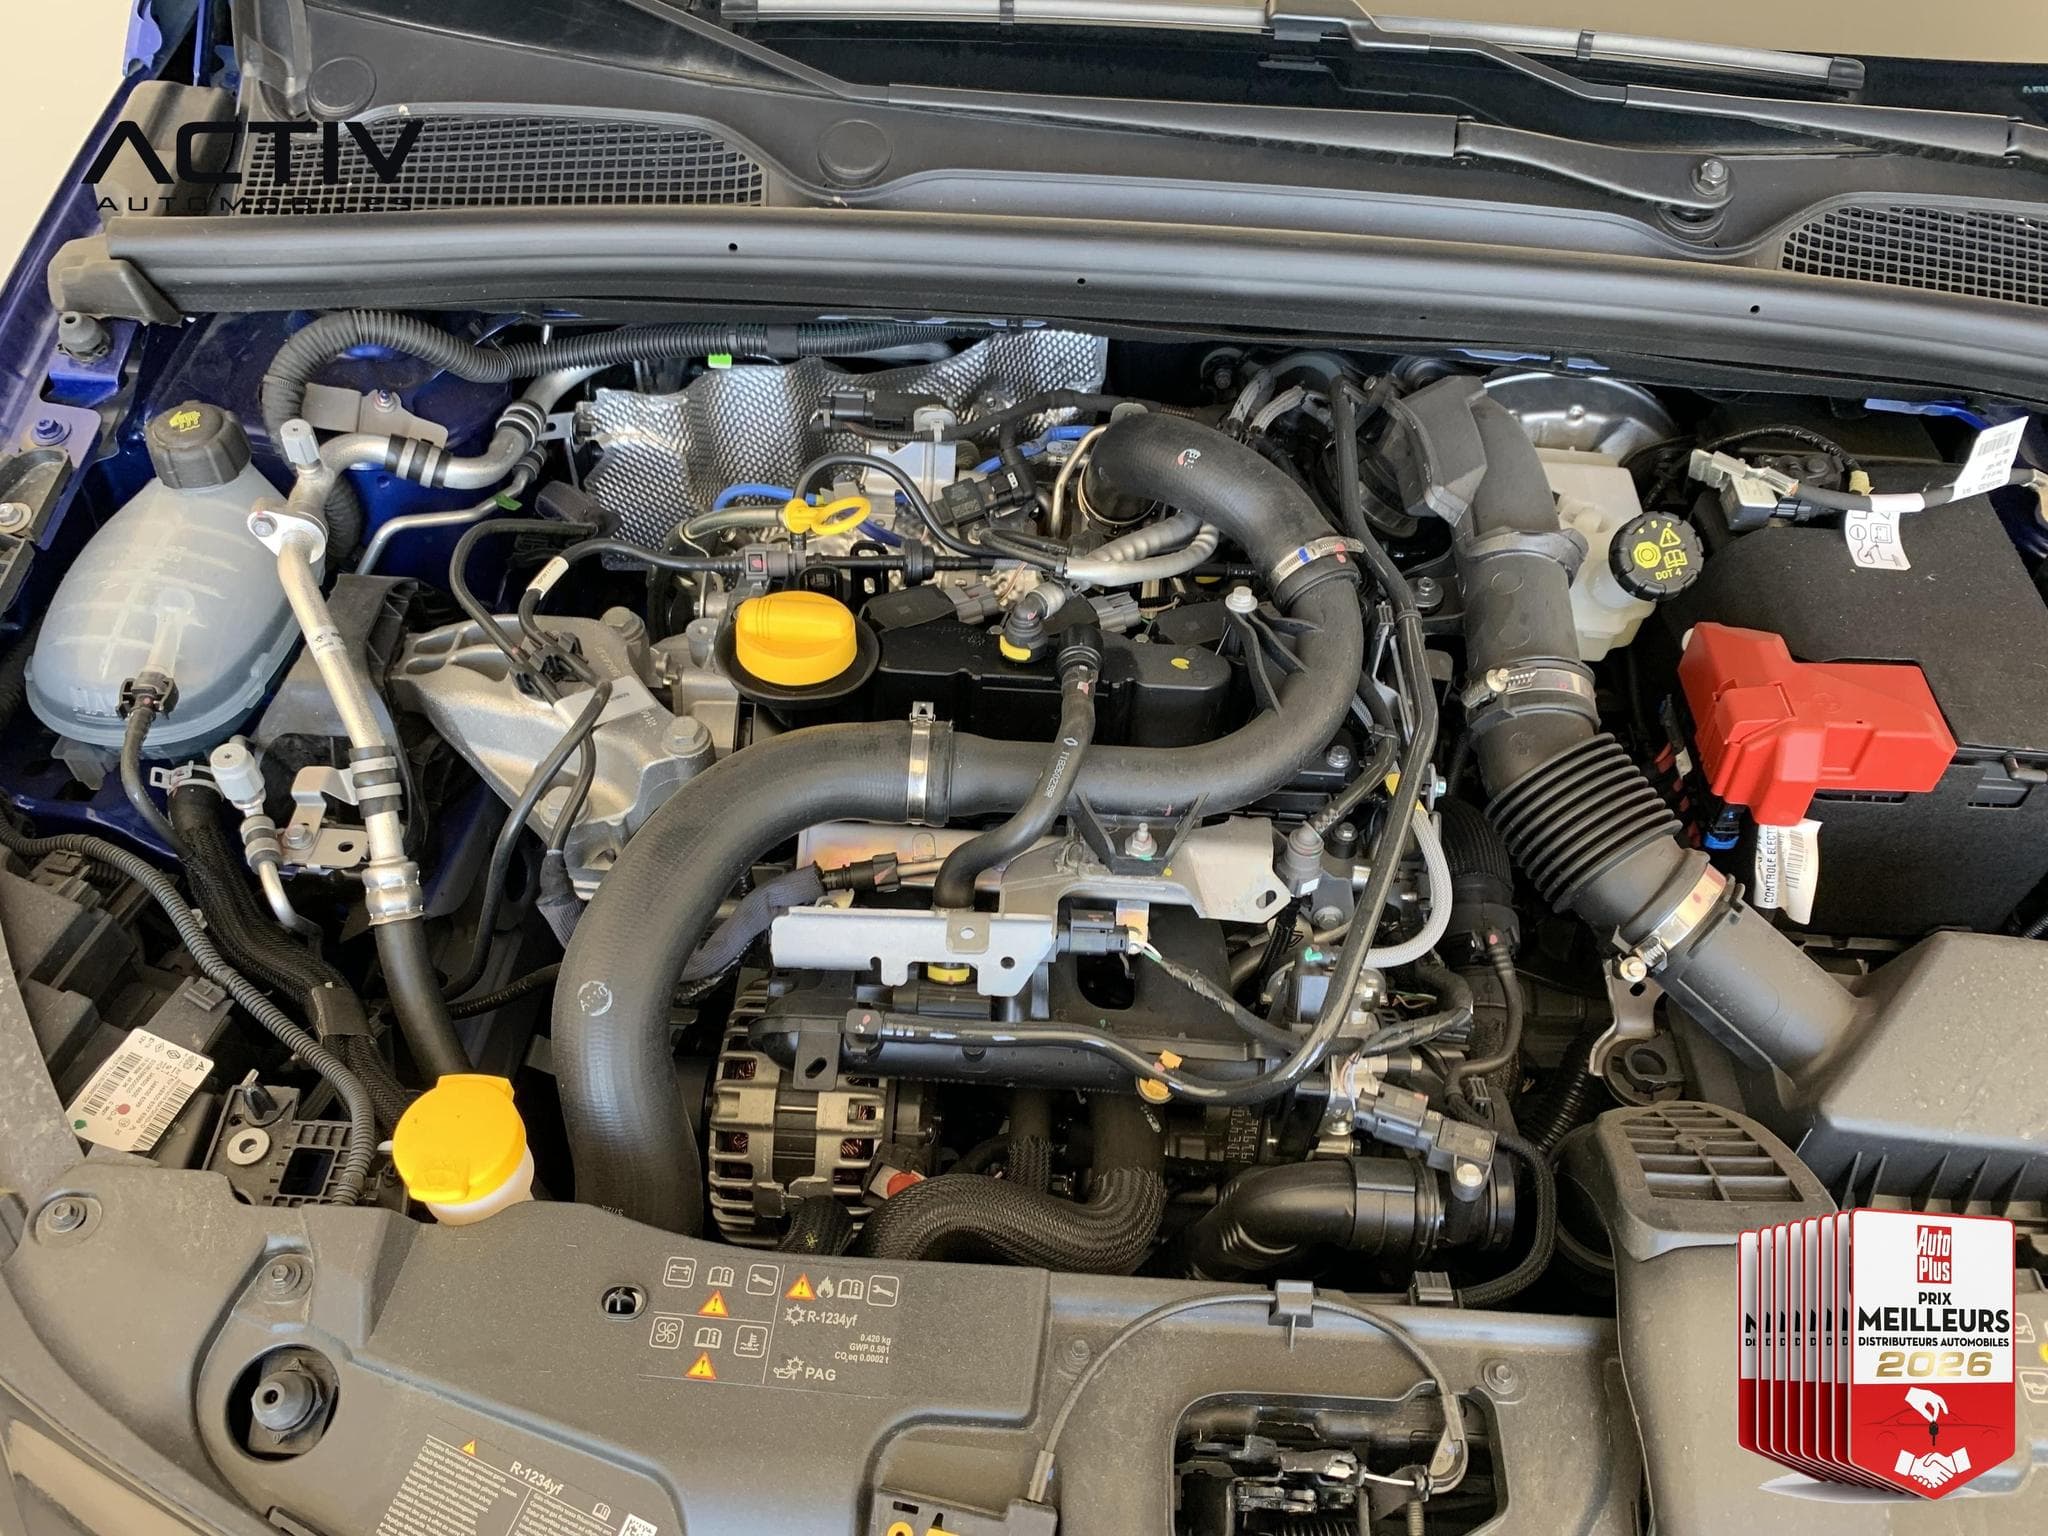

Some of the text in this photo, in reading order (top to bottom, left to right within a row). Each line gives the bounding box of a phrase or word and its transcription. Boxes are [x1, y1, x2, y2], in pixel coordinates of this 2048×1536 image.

[1655, 568, 1682, 580] DOT 4
[1764, 858, 1777, 903] CONTROLE
[807, 1311, 858, 1329] R-1234yf
[860, 1334, 891, 1345] 0.420 kg
[850, 1343, 868, 1352] GWP
[805, 1367, 836, 1381] PAG
[510, 1460, 565, 1496] R-1234yf
